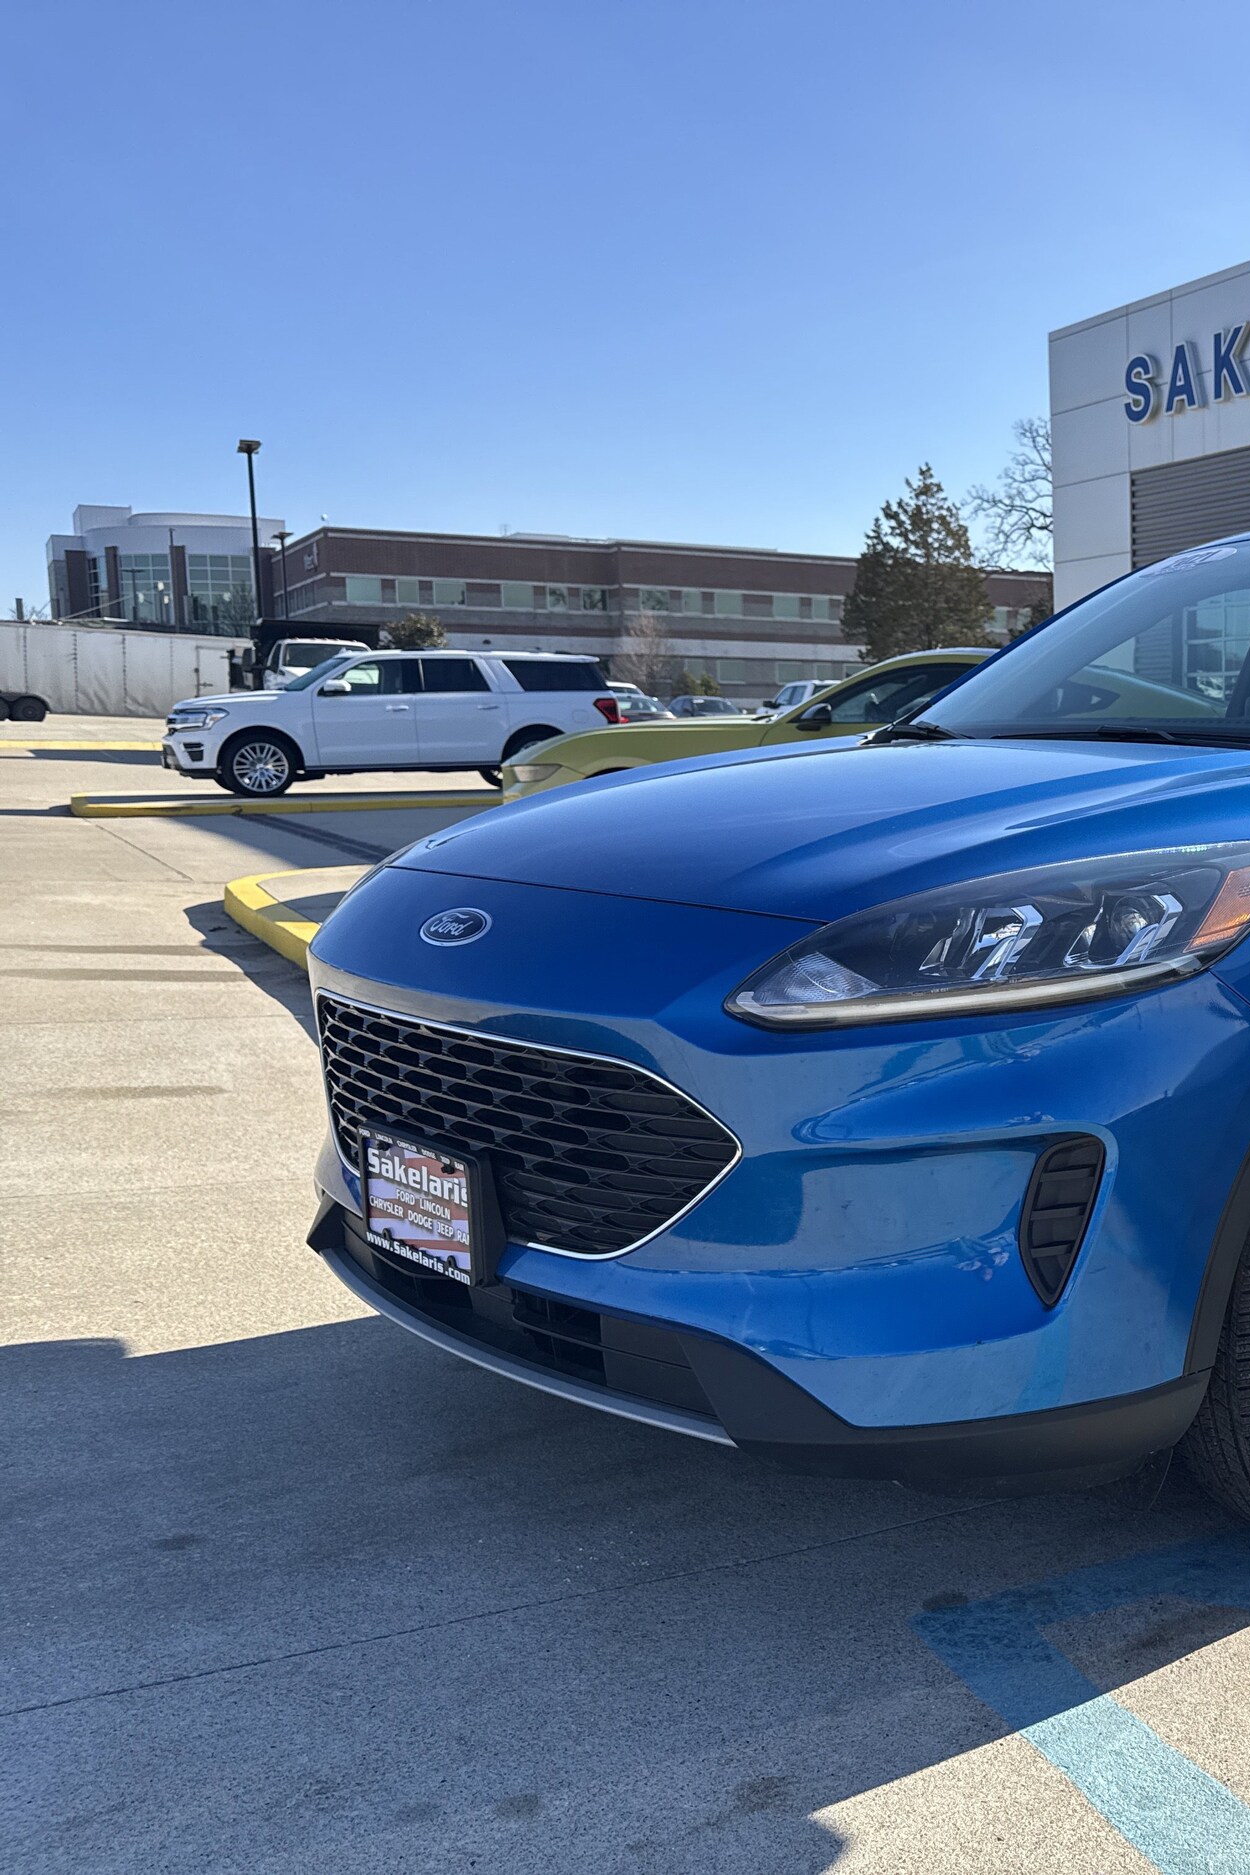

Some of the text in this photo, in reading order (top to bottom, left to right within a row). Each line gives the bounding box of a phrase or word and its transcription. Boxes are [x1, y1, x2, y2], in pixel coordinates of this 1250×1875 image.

[430, 913, 473, 936] Ford
[369, 1195, 404, 1218] CHRYSLER
[408, 1209, 433, 1230] DODGE
[437, 1222, 454, 1237] JEEP
[396, 1188, 451, 1220] FORD LINCOLN
